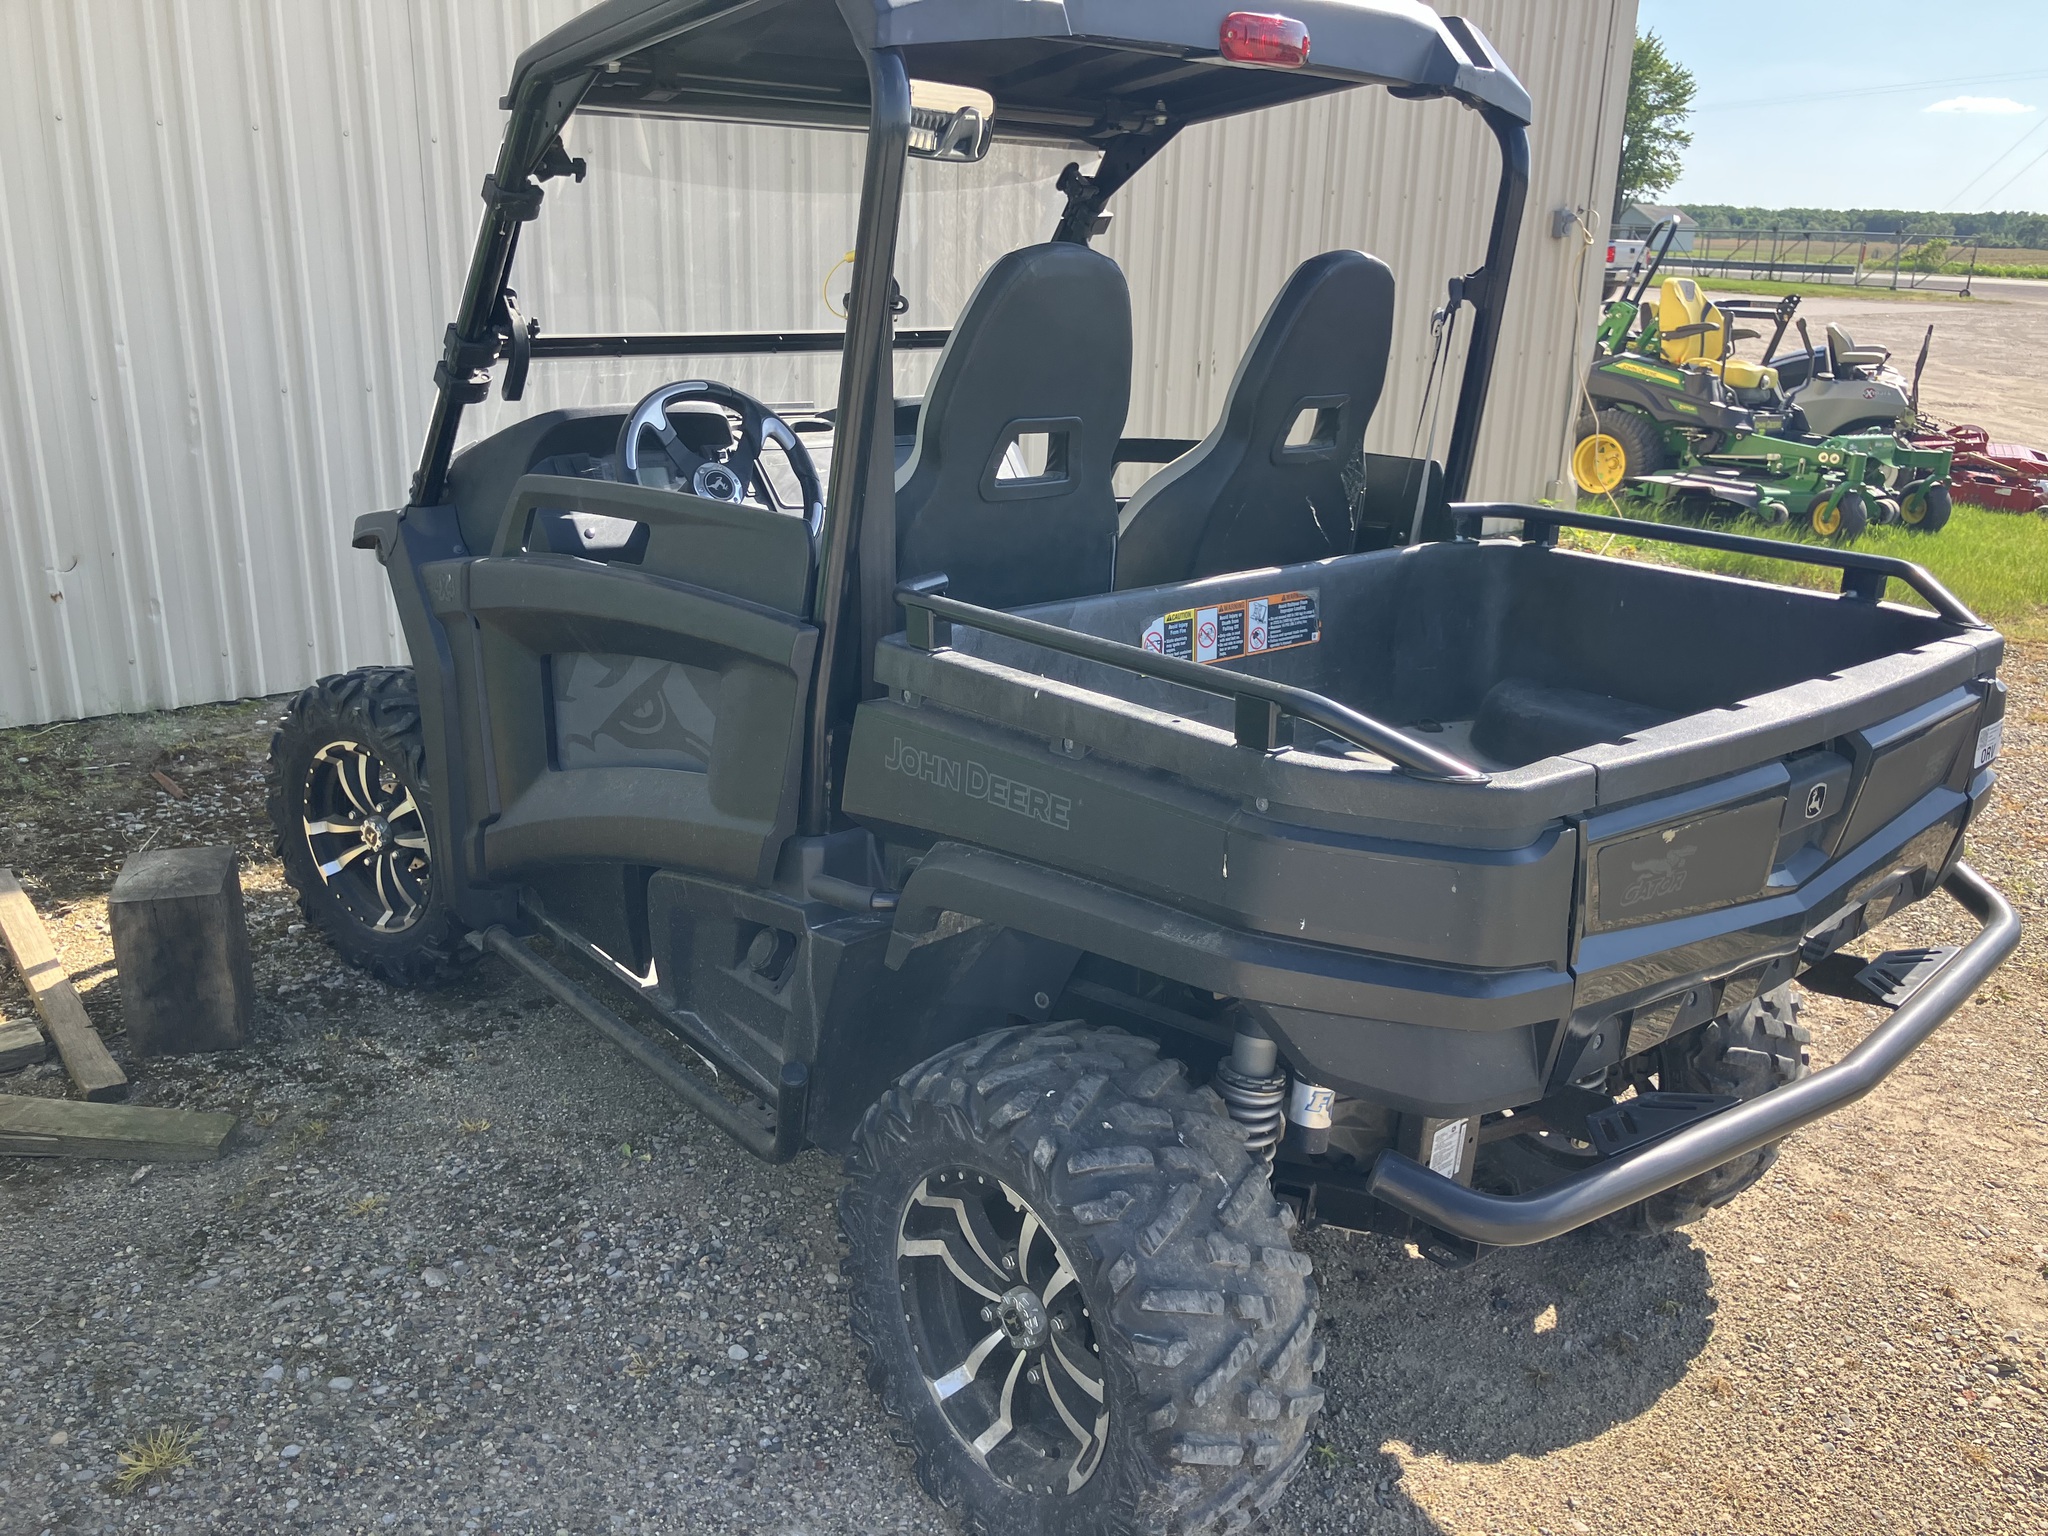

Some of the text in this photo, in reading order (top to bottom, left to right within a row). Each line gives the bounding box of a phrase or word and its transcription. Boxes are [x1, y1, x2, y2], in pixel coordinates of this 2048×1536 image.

[1172, 611, 1192, 620] CAUTION
[885, 737, 1071, 830] JOHN DEERE
[1620, 870, 1687, 907] GATOR
